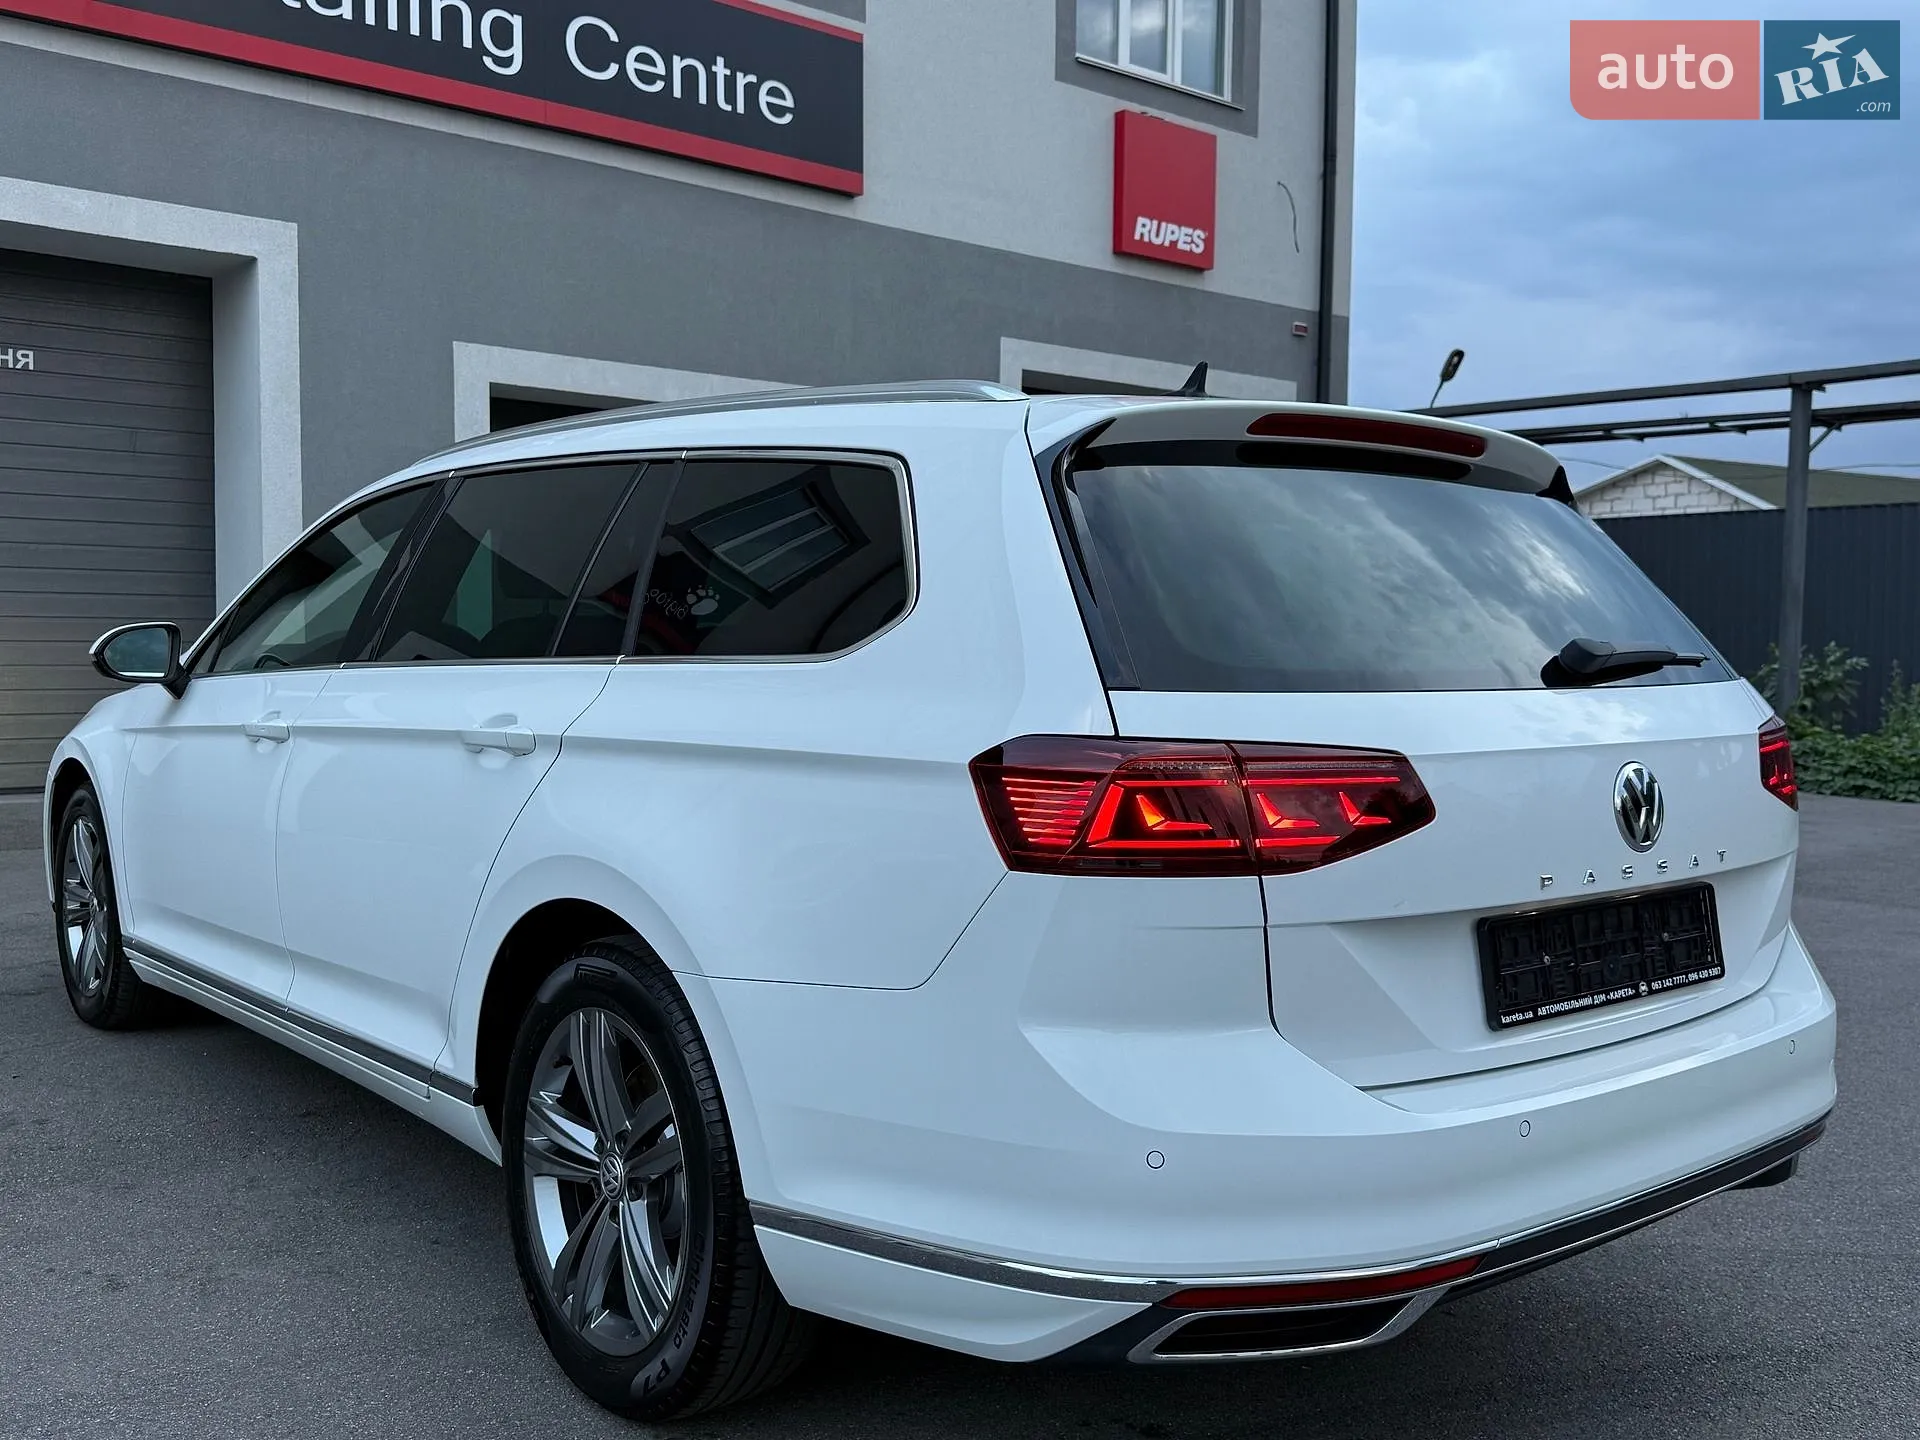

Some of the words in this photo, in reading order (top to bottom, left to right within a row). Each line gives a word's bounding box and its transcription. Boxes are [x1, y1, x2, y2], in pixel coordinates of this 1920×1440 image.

[565, 15, 795, 125] Centre
[1134, 216, 1206, 254] RUPES
[1540, 849, 1728, 890] PASSAT
[1500, 1009, 1534, 1024] kareta.ua
[1538, 995, 1593, 1016] АВТОМОБІЛЬНИЙ
